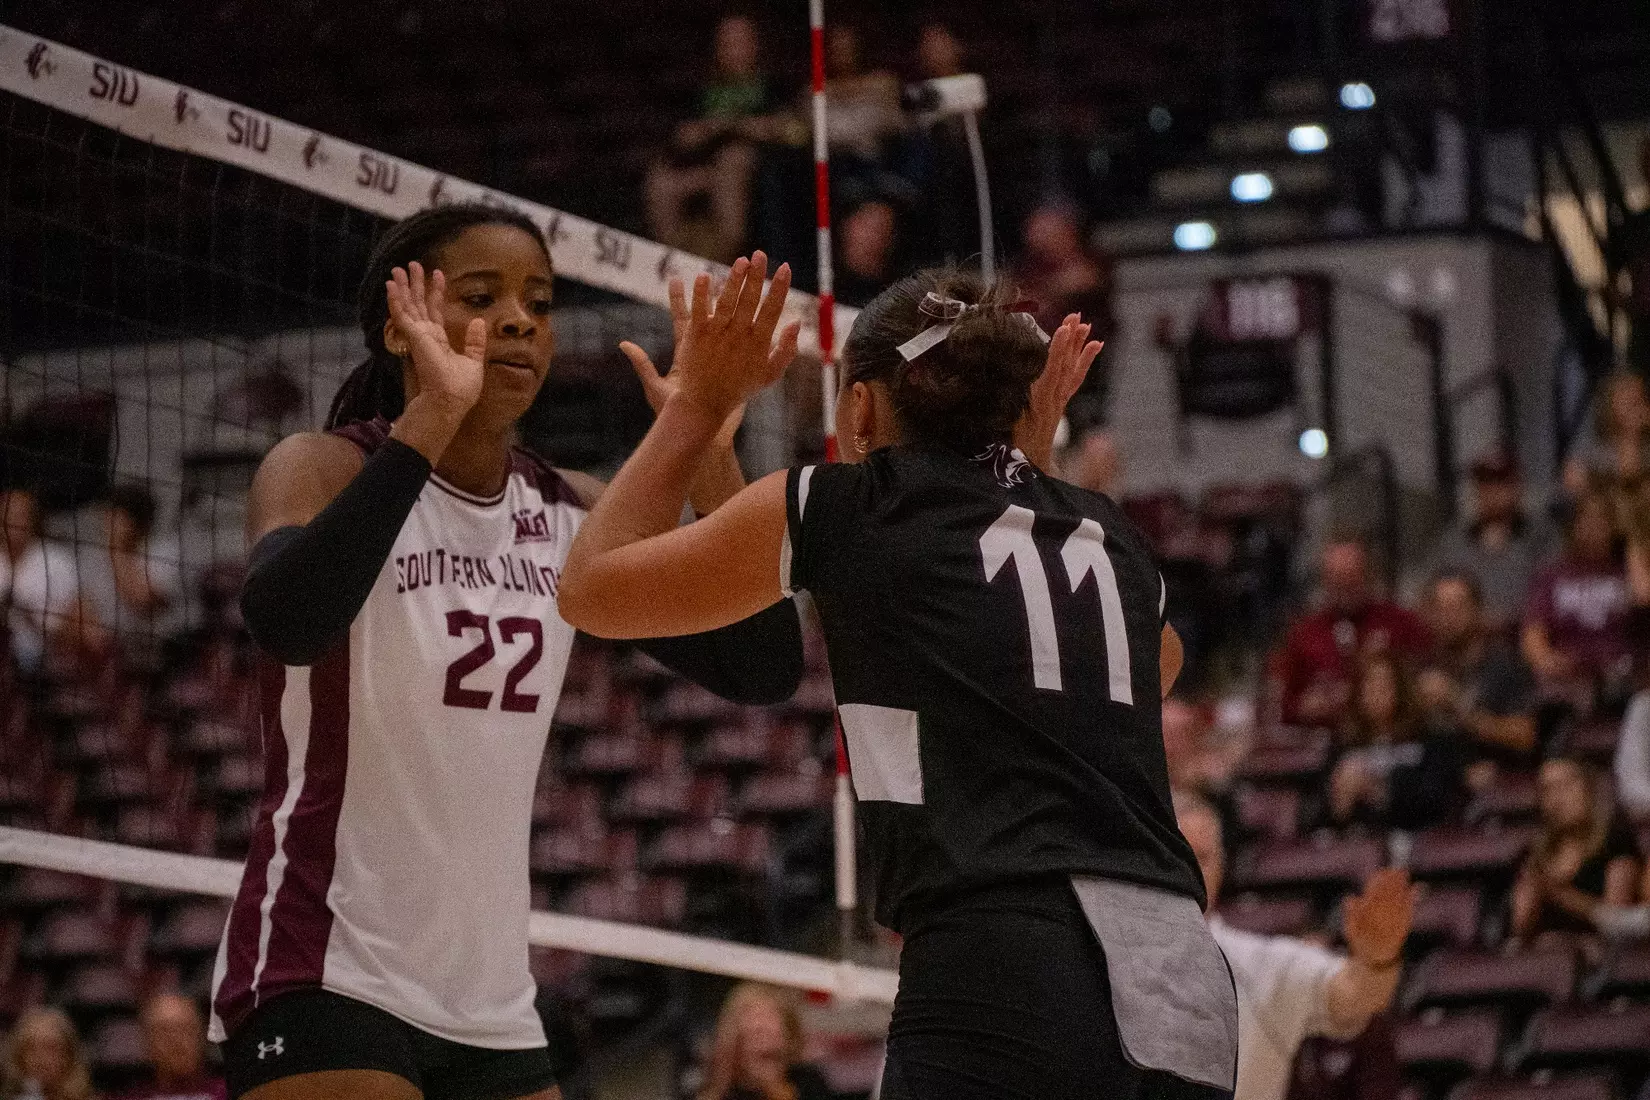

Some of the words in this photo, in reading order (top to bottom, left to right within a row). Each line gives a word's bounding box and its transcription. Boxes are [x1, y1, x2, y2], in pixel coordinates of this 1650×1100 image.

[89, 62, 140, 107] SIU
[226, 108, 272, 154] SIU
[356, 152, 400, 195] SIU
[396, 549, 496, 594] SOUTERN
[978, 503, 1134, 706] 11
[443, 609, 544, 713] 22
